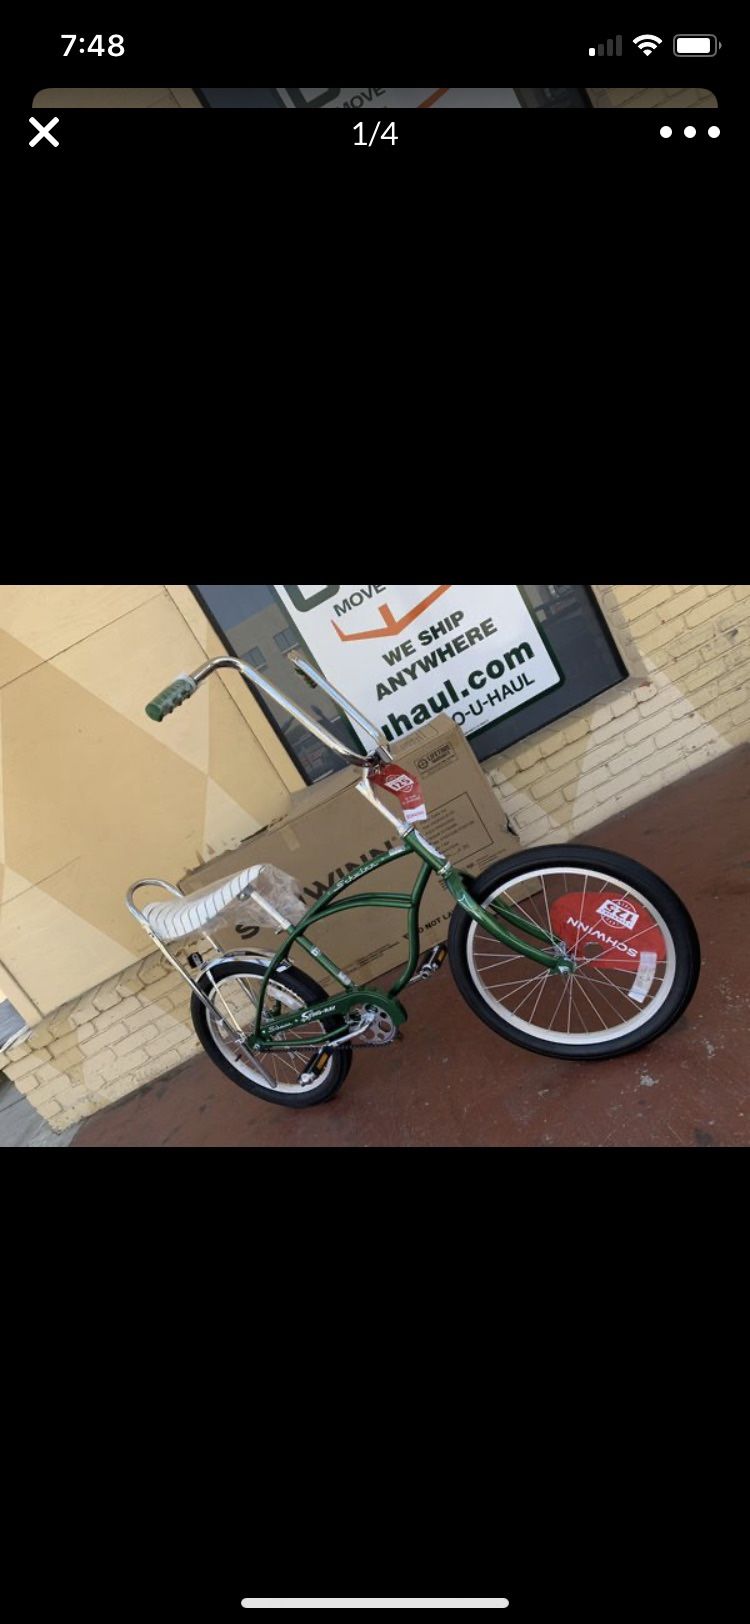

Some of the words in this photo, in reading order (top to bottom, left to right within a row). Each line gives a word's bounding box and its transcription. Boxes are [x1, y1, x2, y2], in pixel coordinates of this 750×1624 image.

[333, 585, 386, 617] MOVE
[375, 617, 498, 701] ANYWHERE
[382, 640, 416, 667] WE
[418, 610, 464, 646] SHIP
[425, 917, 441, 931] NOT
[566, 916, 639, 957] SCHWINN
